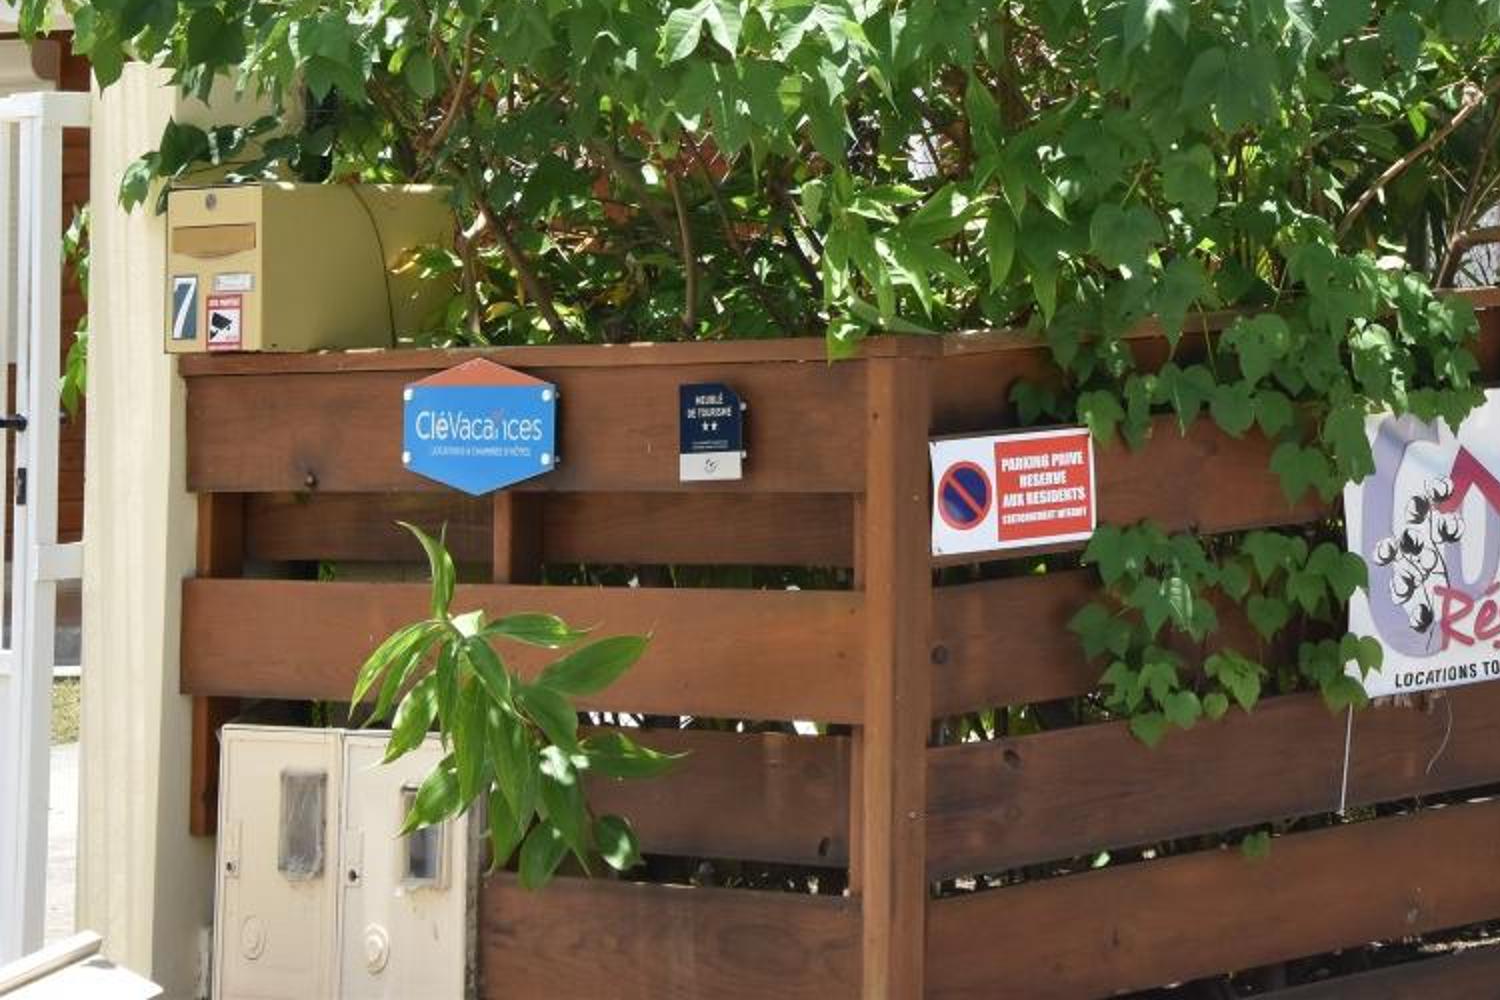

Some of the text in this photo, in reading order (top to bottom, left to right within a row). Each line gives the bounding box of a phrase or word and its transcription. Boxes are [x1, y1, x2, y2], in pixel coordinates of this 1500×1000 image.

[173, 277, 197, 338] 7
[1001, 454, 1049, 472] PARKING
[1003, 493, 1024, 508] AUX
[1394, 663, 1477, 689] LOCATIONS
